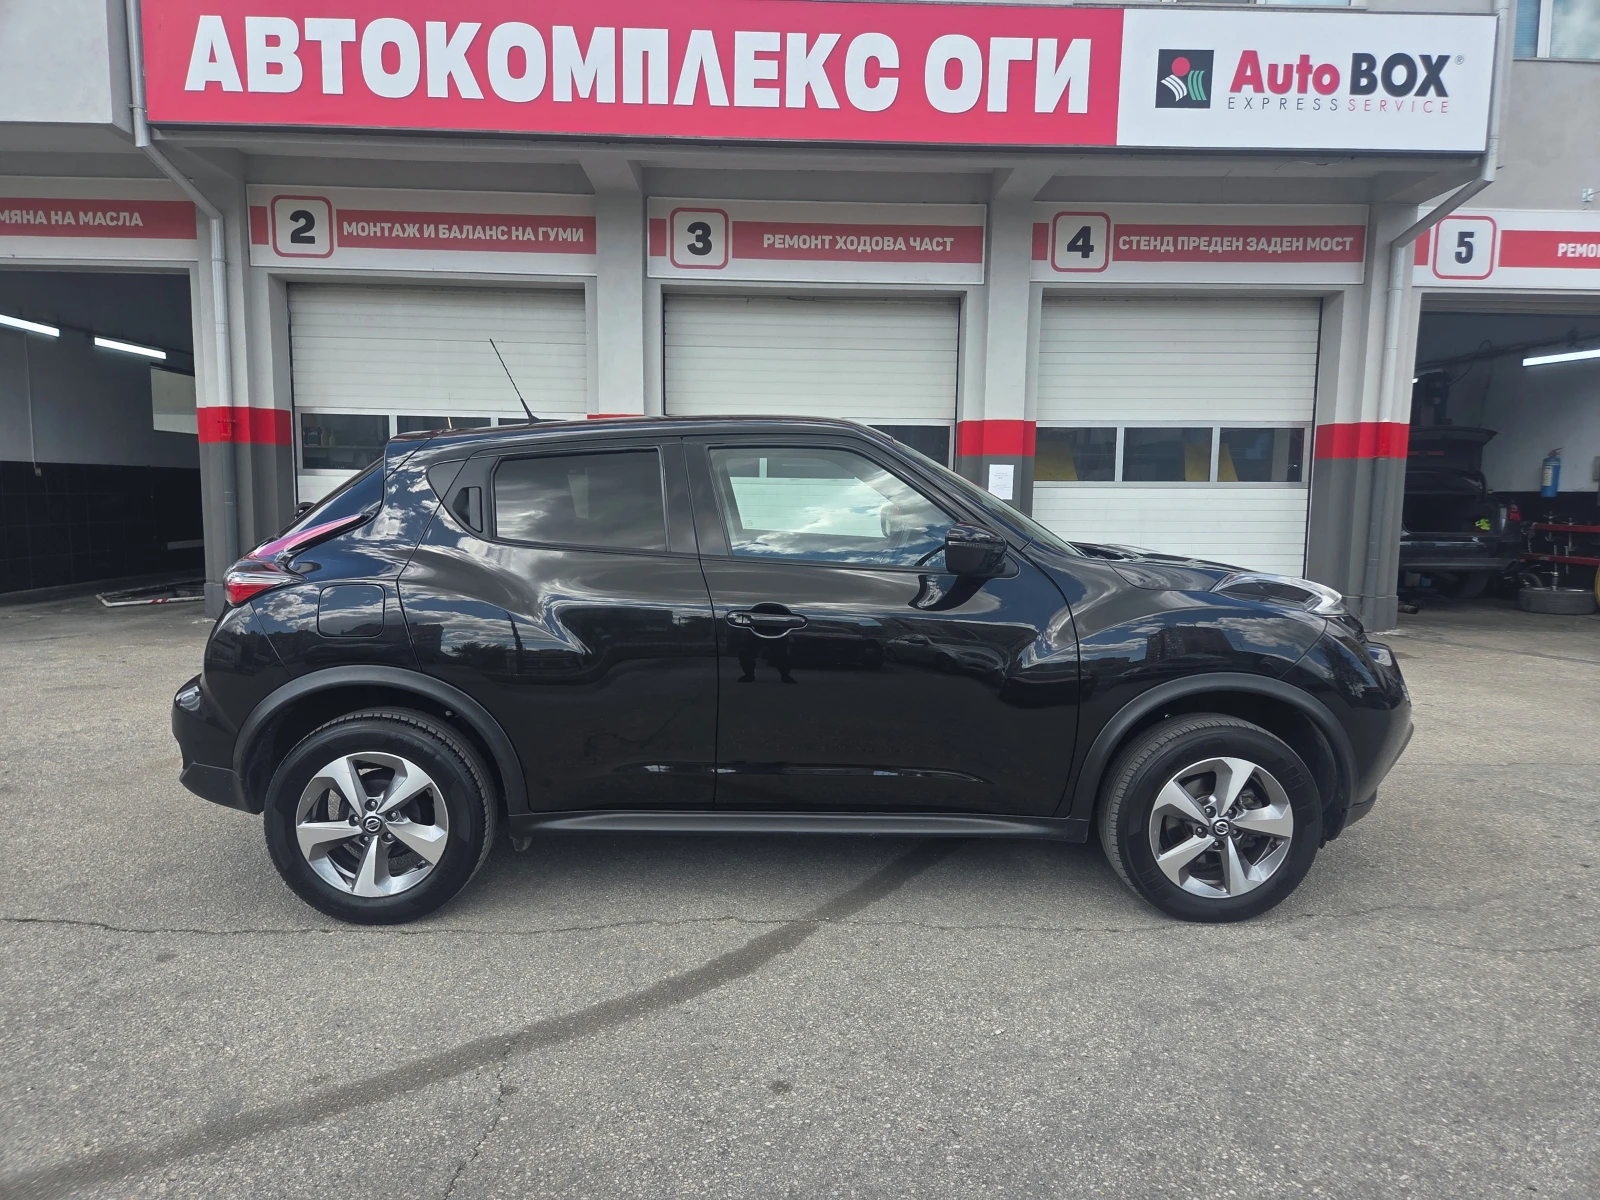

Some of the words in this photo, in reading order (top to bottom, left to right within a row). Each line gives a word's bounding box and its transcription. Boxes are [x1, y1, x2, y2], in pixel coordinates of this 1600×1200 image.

[184, 15, 899, 112] АВТОКОМПЛЕКС
[924, 34, 1092, 114] ОГИ
[1229, 50, 1341, 95] Auto
[1349, 52, 1451, 98] BOX
[51, 211, 76, 225] НА
[79, 211, 144, 227] МАСЛА
[289, 209, 316, 244] 2
[343, 221, 421, 238] МОНТАЖ
[423, 223, 436, 238] И
[438, 223, 509, 241] БАЛАНС
[511, 226, 535, 241] НА
[538, 227, 584, 242] ГУМИ
[687, 221, 713, 256] 3
[763, 234, 832, 249] РЕМОНТ
[834, 235, 907, 252] ХОДОВА
[909, 237, 954, 251] ЧАСТ
[1066, 226, 1094, 259] 4
[1118, 236, 1174, 252] СТЕНД
[1177, 236, 1243, 253] ПРЕДЕН
[1246, 237, 1304, 253] ЗАДЕН
[1306, 237, 1354, 252] МОСТ
[1455, 231, 1475, 264] 5
